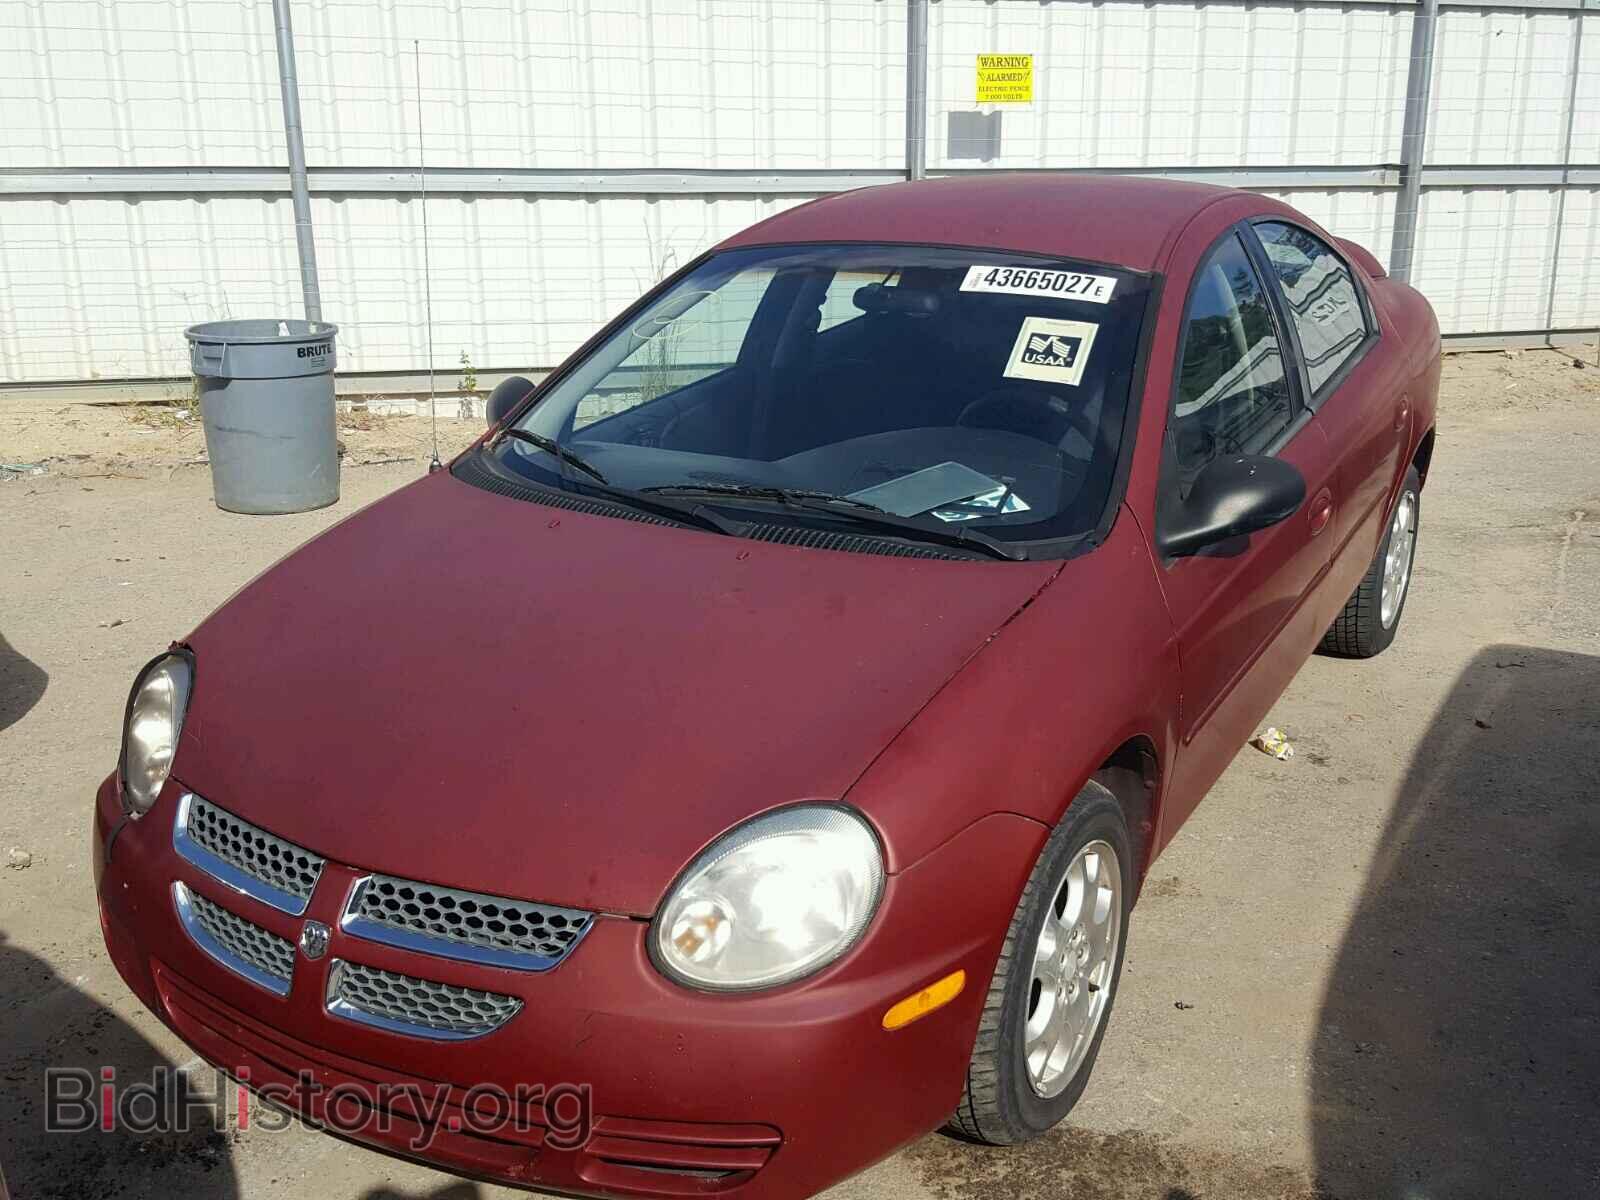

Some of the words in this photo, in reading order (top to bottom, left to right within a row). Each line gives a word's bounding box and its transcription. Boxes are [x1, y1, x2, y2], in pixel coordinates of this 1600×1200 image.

[980, 57, 1029, 68] WARNING
[986, 72, 1023, 82] ALARMED
[984, 268, 1096, 295] 43665027
[1094, 286, 1104, 296] E
[297, 343, 332, 358] BRUTE
[1024, 353, 1065, 367] USAA
